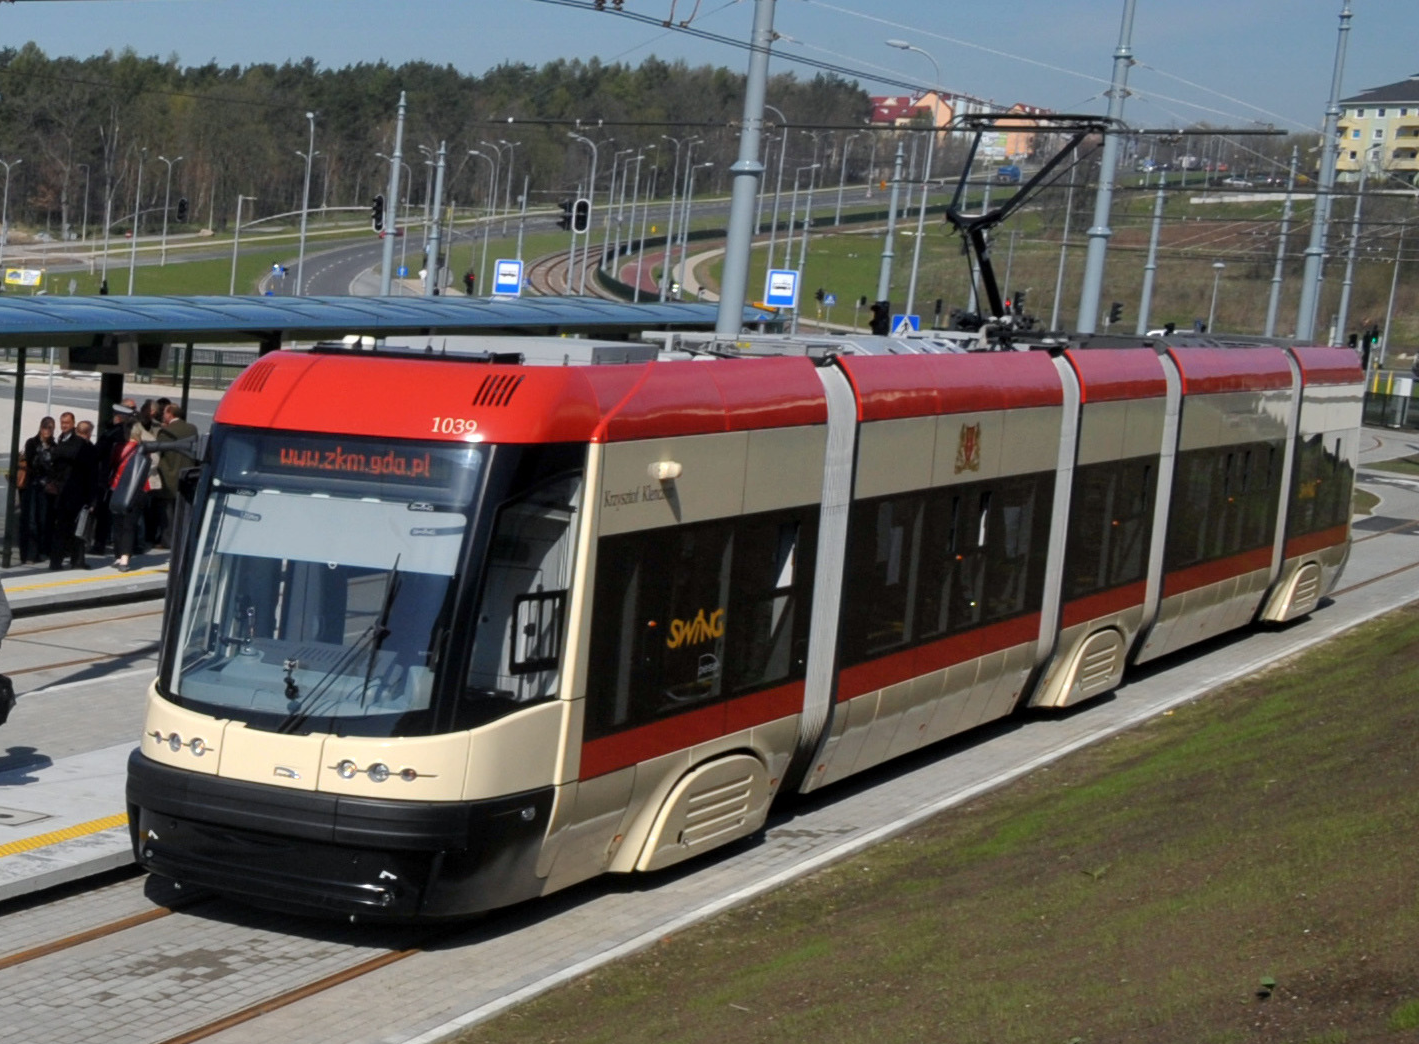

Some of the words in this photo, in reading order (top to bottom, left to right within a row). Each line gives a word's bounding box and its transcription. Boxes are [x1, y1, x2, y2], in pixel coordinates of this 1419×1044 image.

[431, 416, 478, 435] 1039
[279, 446, 432, 478] www.zkm.gda.pl
[603, 485, 640, 511] Krzysztof
[666, 608, 725, 649] SWING
